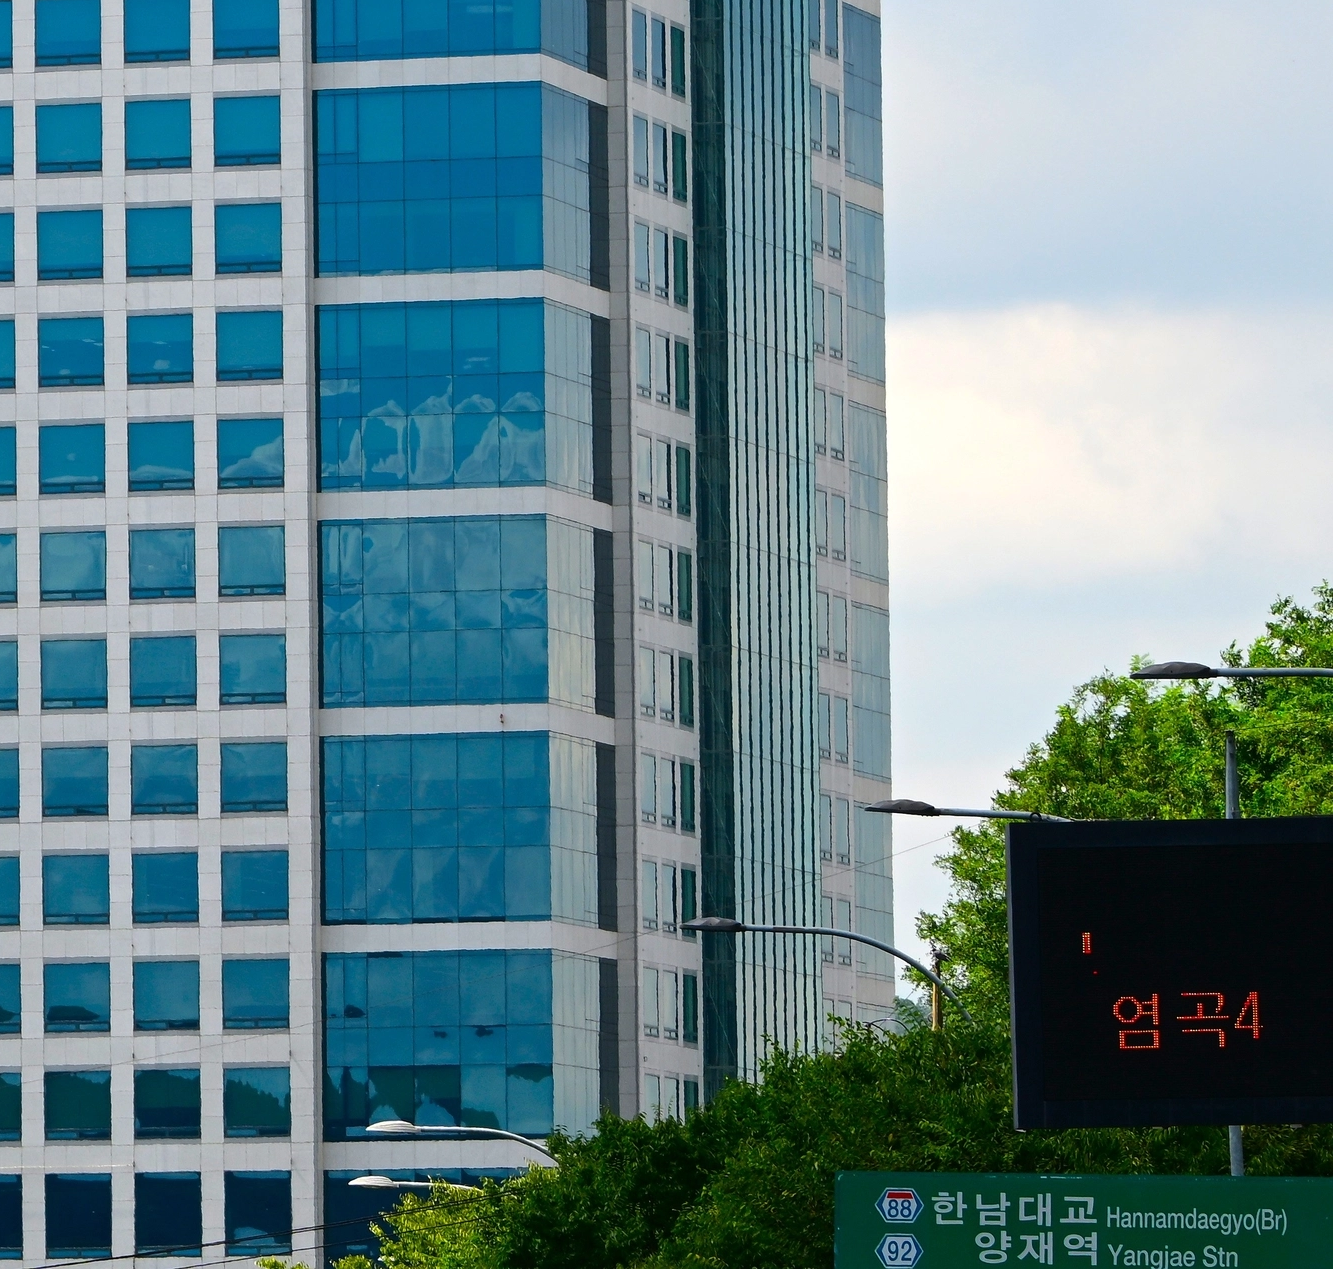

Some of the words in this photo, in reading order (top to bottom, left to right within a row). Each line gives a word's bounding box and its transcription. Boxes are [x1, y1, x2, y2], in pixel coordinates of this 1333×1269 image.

[887, 1198, 912, 1219] 88
[931, 1191, 1098, 1227] 한남대교
[1106, 1206, 1288, 1235] Hannamdaegyo(Br)
[887, 1240, 912, 1262] 92
[974, 1230, 1098, 1266] 양재역
[1107, 1243, 1196, 1269] Yangjae
[1202, 1244, 1238, 1268] Stn
